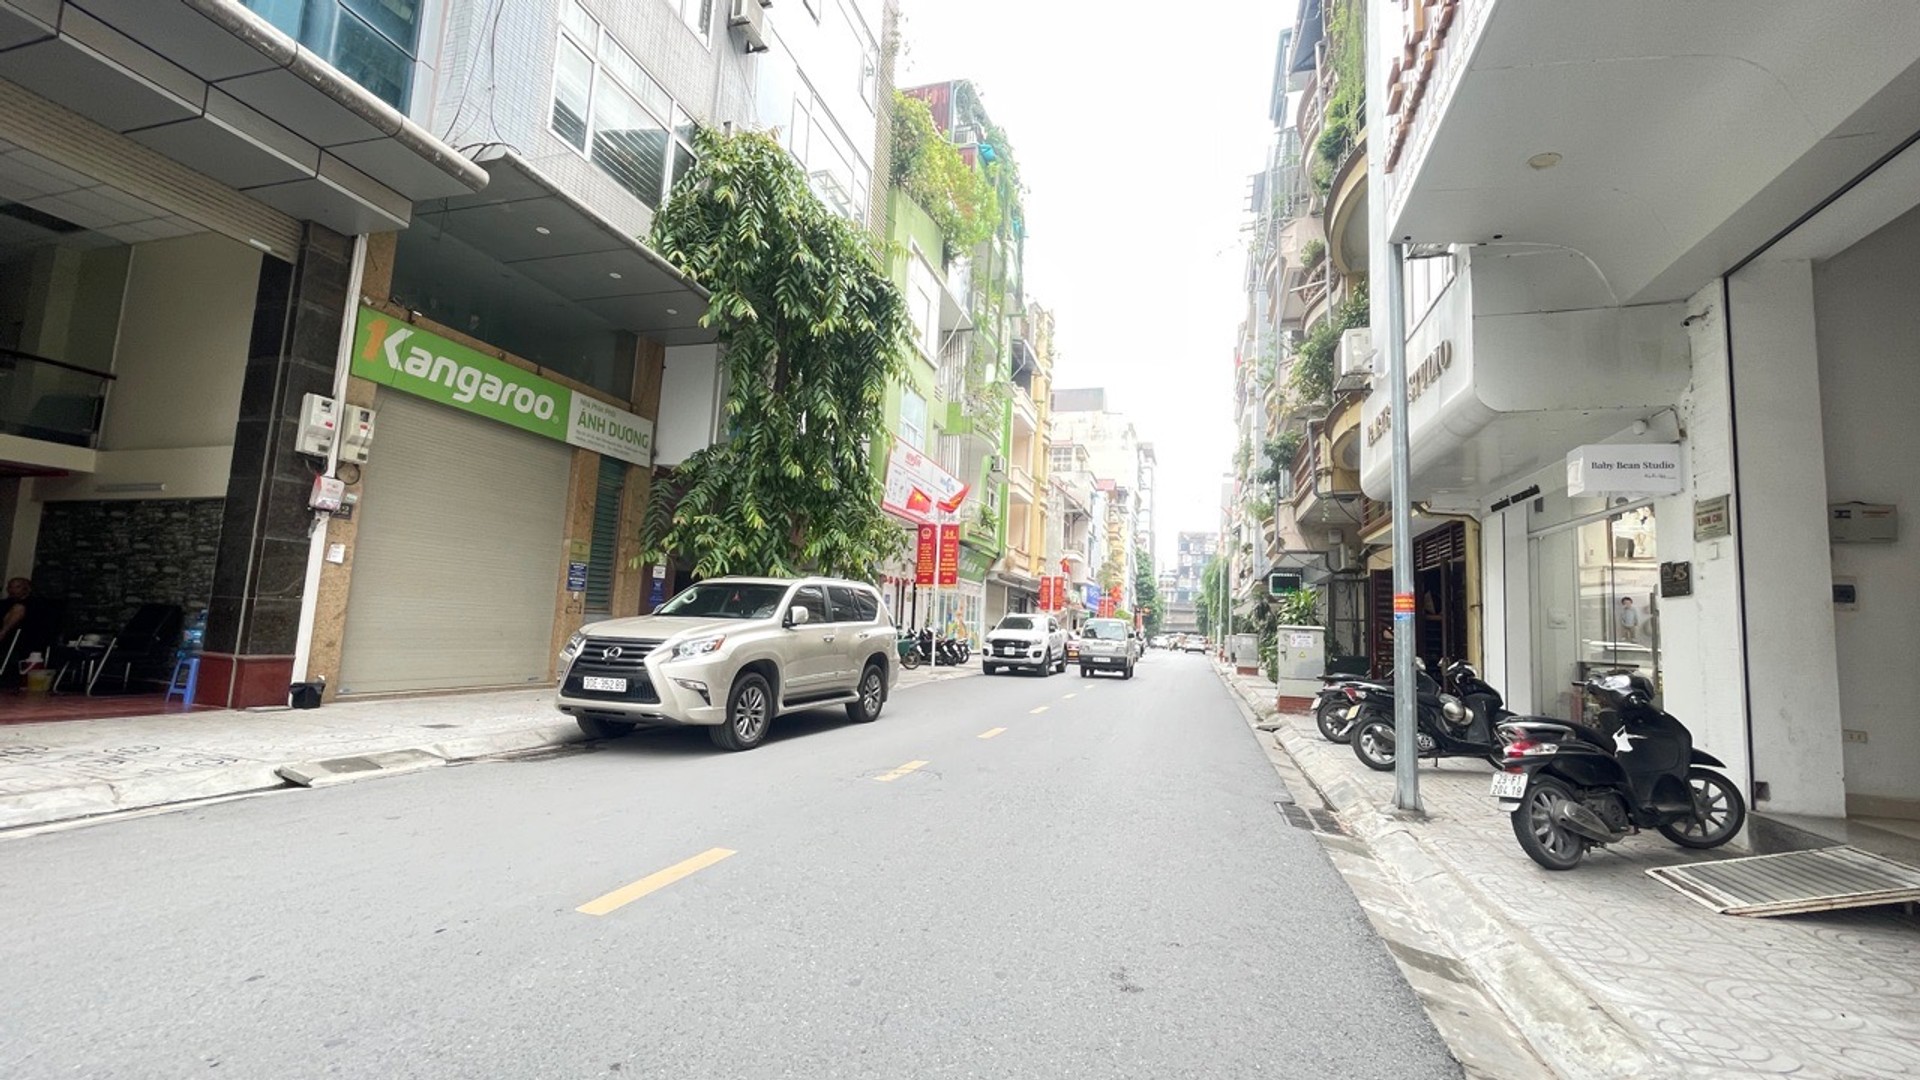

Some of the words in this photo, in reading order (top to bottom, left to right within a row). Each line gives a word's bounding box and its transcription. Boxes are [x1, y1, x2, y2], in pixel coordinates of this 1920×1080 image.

[577, 408, 606, 434] ÁNH
[1591, 461, 1613, 471] Baby
[1616, 461, 1640, 470] Bean
[1642, 461, 1675, 470] Studio
